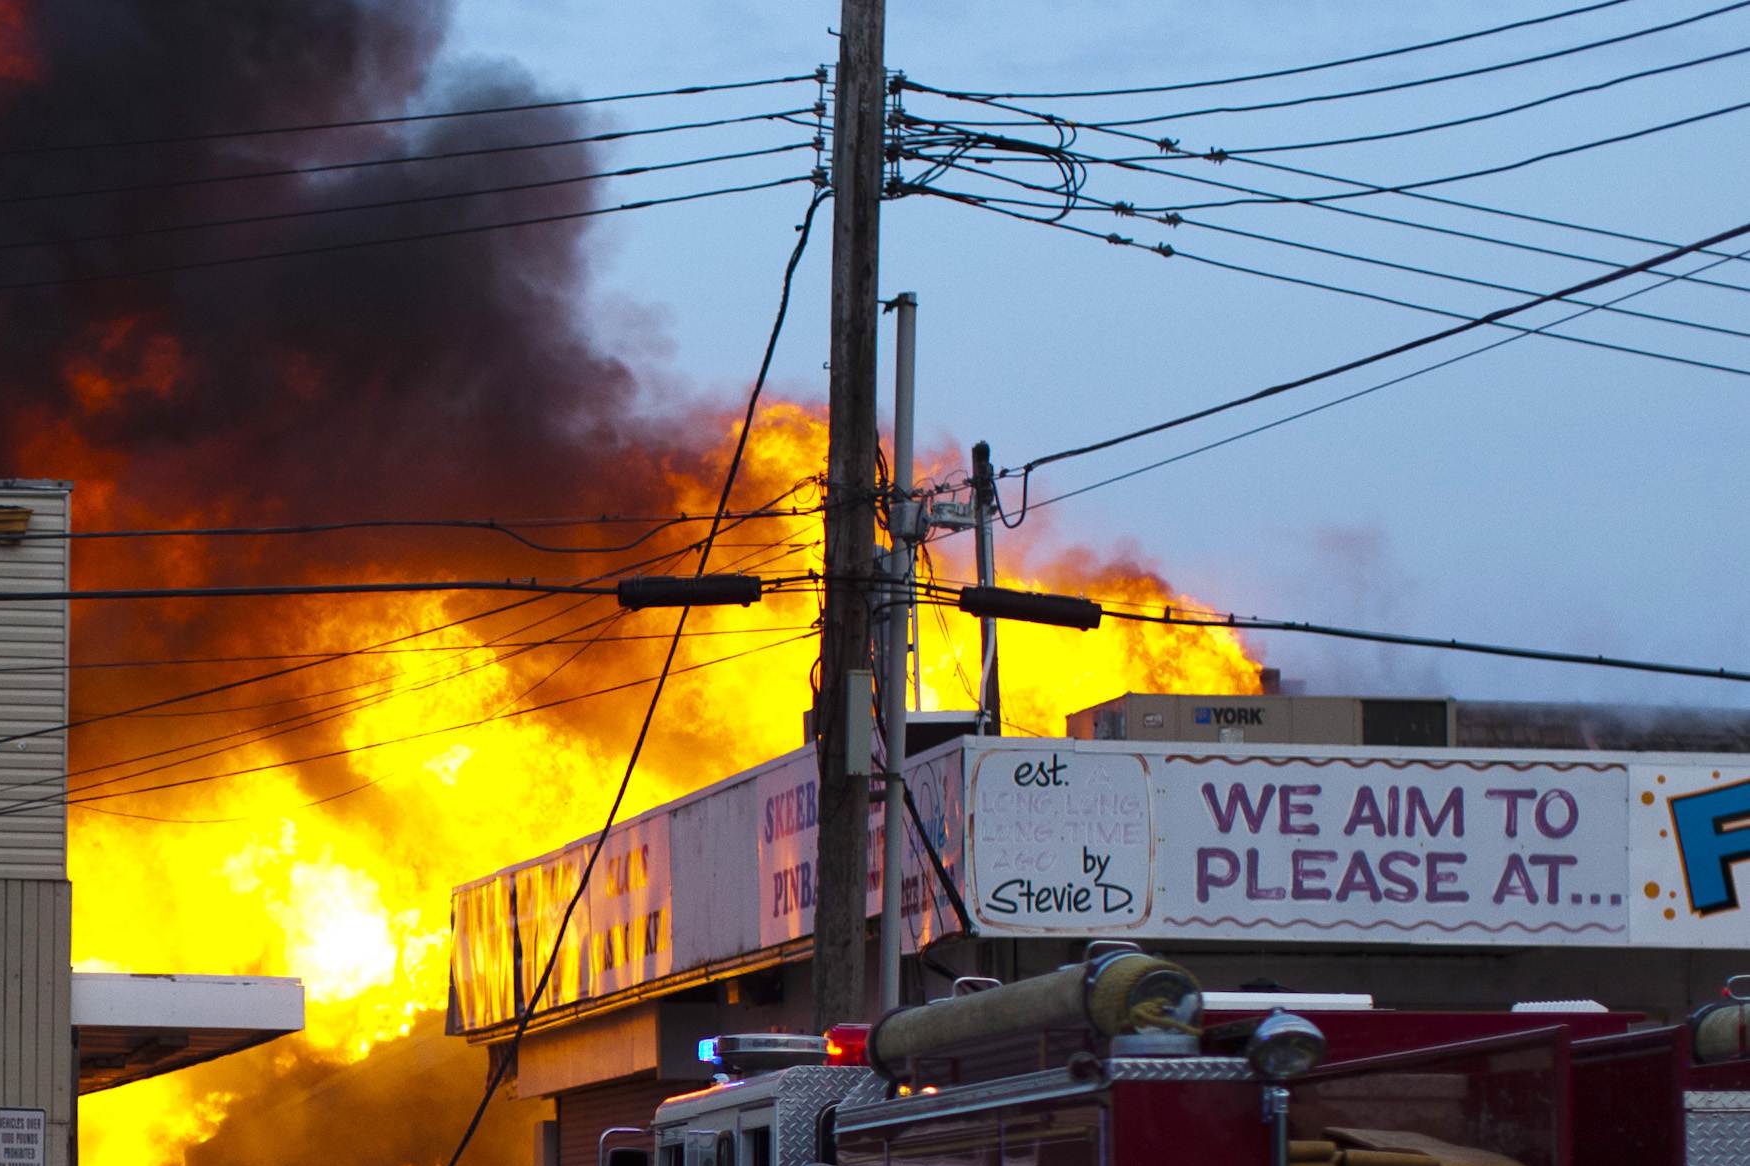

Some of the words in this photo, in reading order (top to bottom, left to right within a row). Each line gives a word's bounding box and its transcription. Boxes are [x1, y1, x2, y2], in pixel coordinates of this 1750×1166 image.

[1212, 707, 1264, 725] YORK
[1013, 753, 1069, 787] est.
[1201, 783, 1322, 835] WE
[1344, 785, 1466, 838] AIM
[1485, 788, 1580, 839] TO
[1083, 845, 1111, 882] by
[1196, 847, 1470, 903] PLEASE
[1492, 853, 1623, 905] AT...
[773, 861, 818, 918] PINB
[985, 878, 1092, 914] Stevie
[1095, 882, 1134, 914] D.
[26, 1118, 41, 1129] OVER
